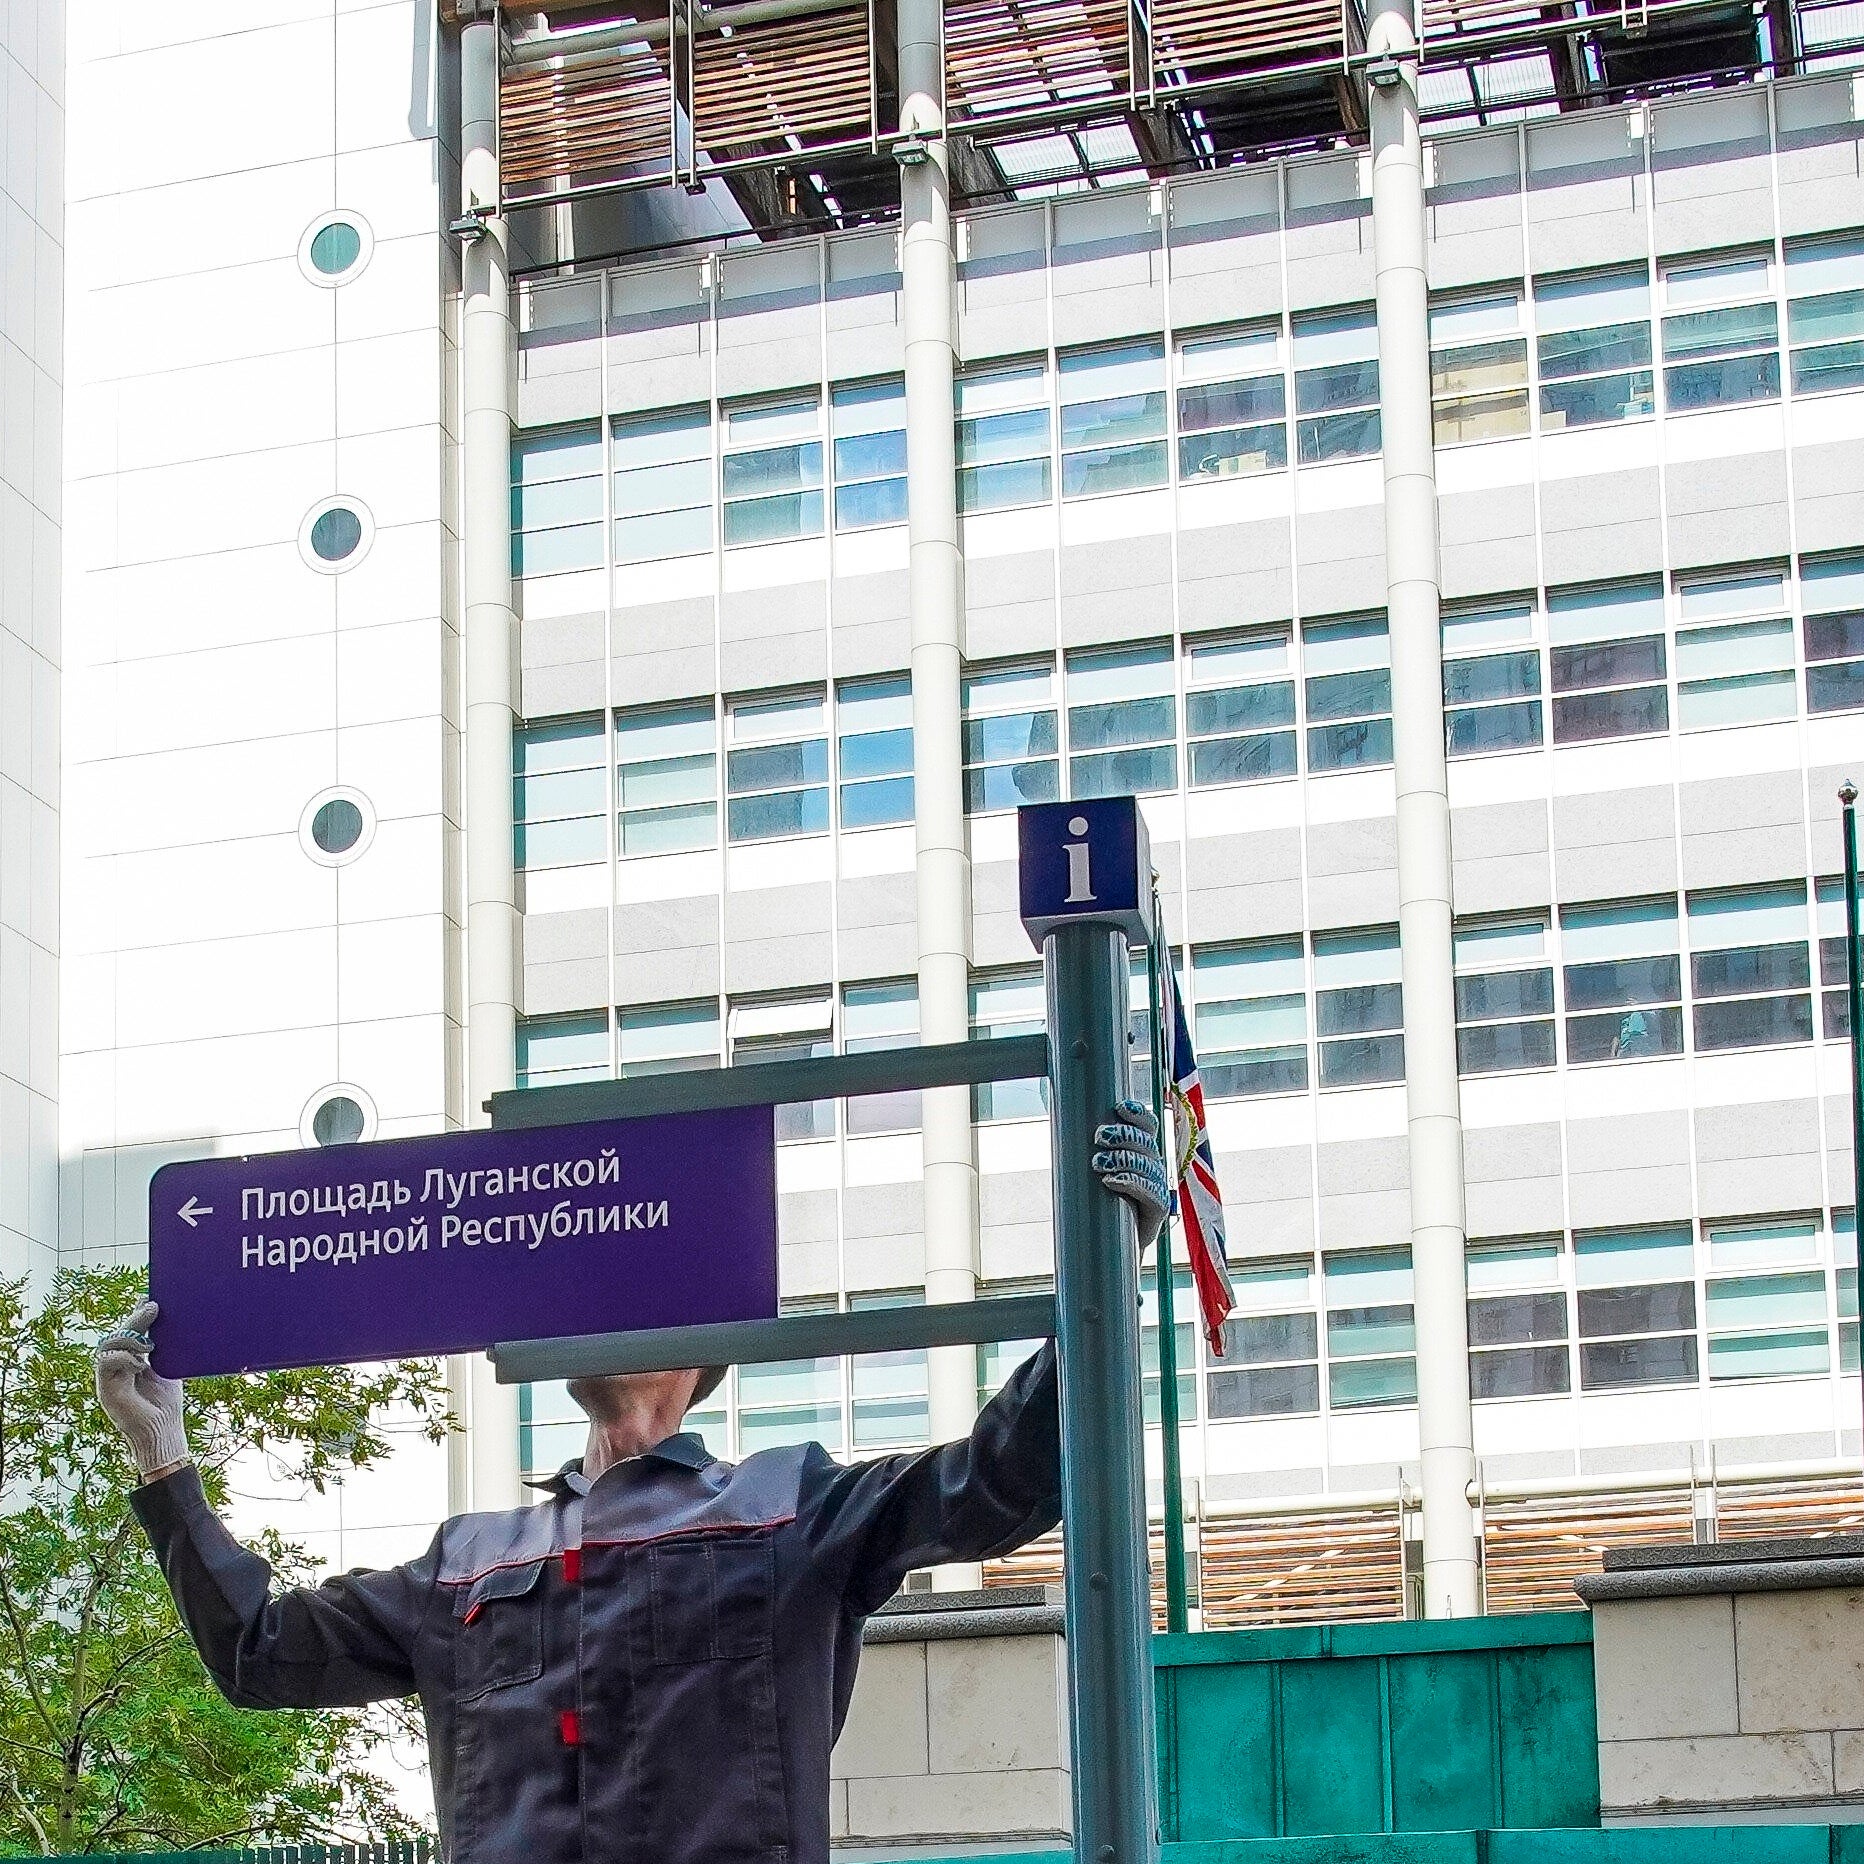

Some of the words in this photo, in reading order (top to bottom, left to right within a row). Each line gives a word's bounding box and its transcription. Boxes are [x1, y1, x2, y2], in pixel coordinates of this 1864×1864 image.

[241, 1179, 412, 1221] Площадь
[420, 1147, 621, 1209] Луганской
[241, 1215, 429, 1273] Народной
[441, 1200, 670, 1250] Республики
